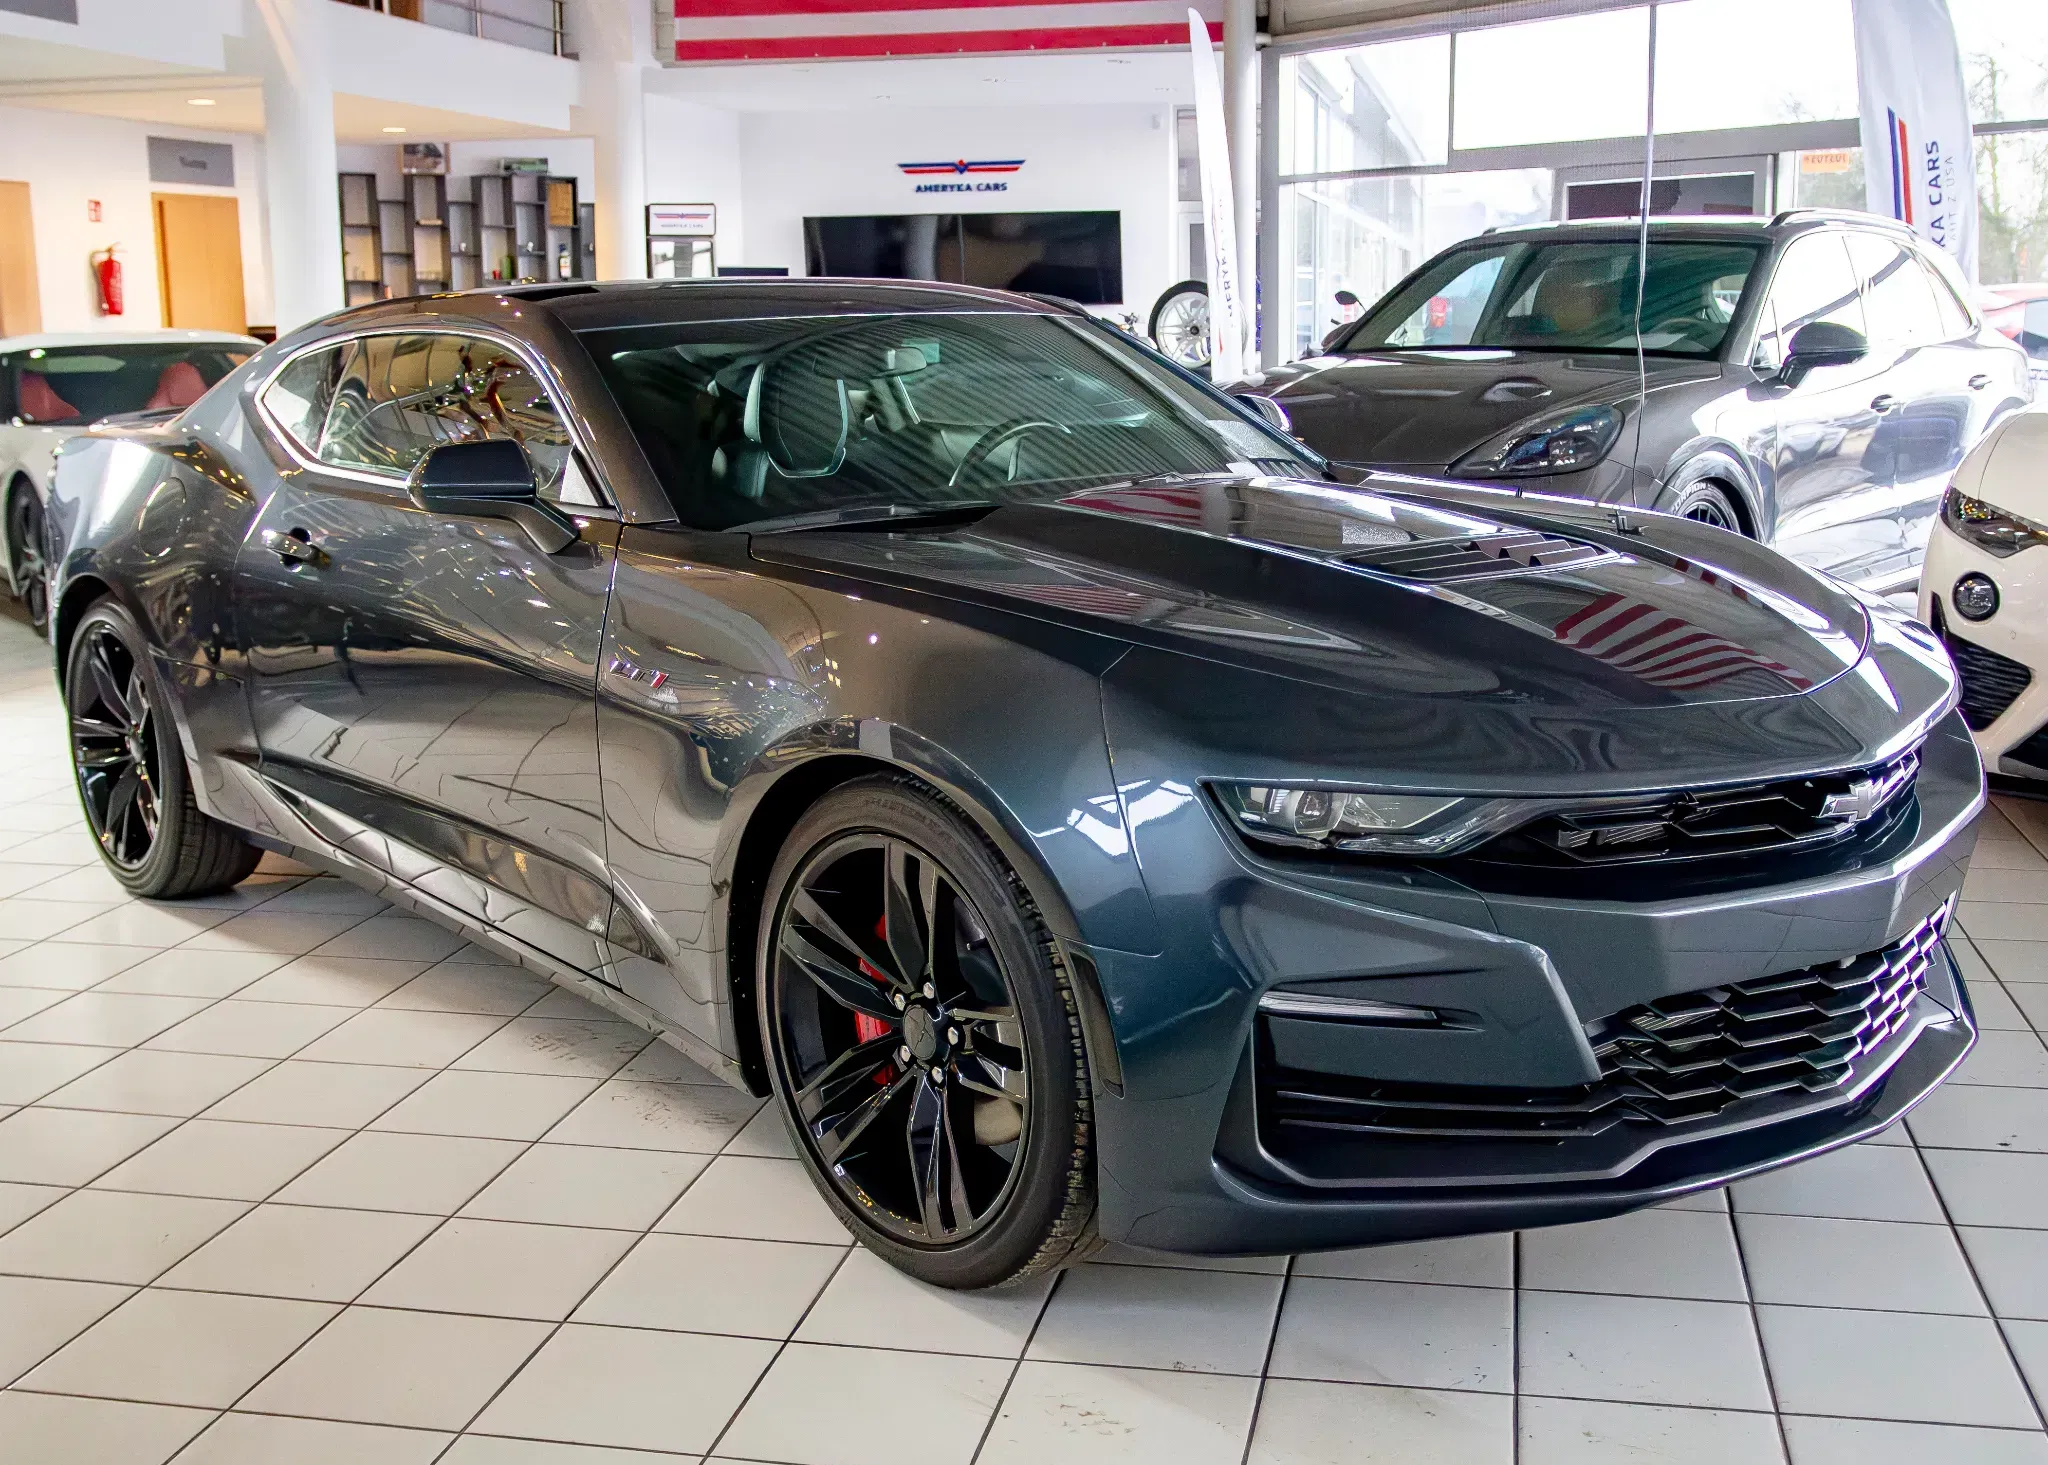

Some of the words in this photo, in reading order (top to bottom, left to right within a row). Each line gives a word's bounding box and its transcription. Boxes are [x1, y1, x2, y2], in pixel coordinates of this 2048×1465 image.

[915, 183, 973, 193] AMERYKA
[976, 182, 1008, 192] CARS
[1925, 141, 1942, 205] CARS
[1944, 156, 1955, 188] USA
